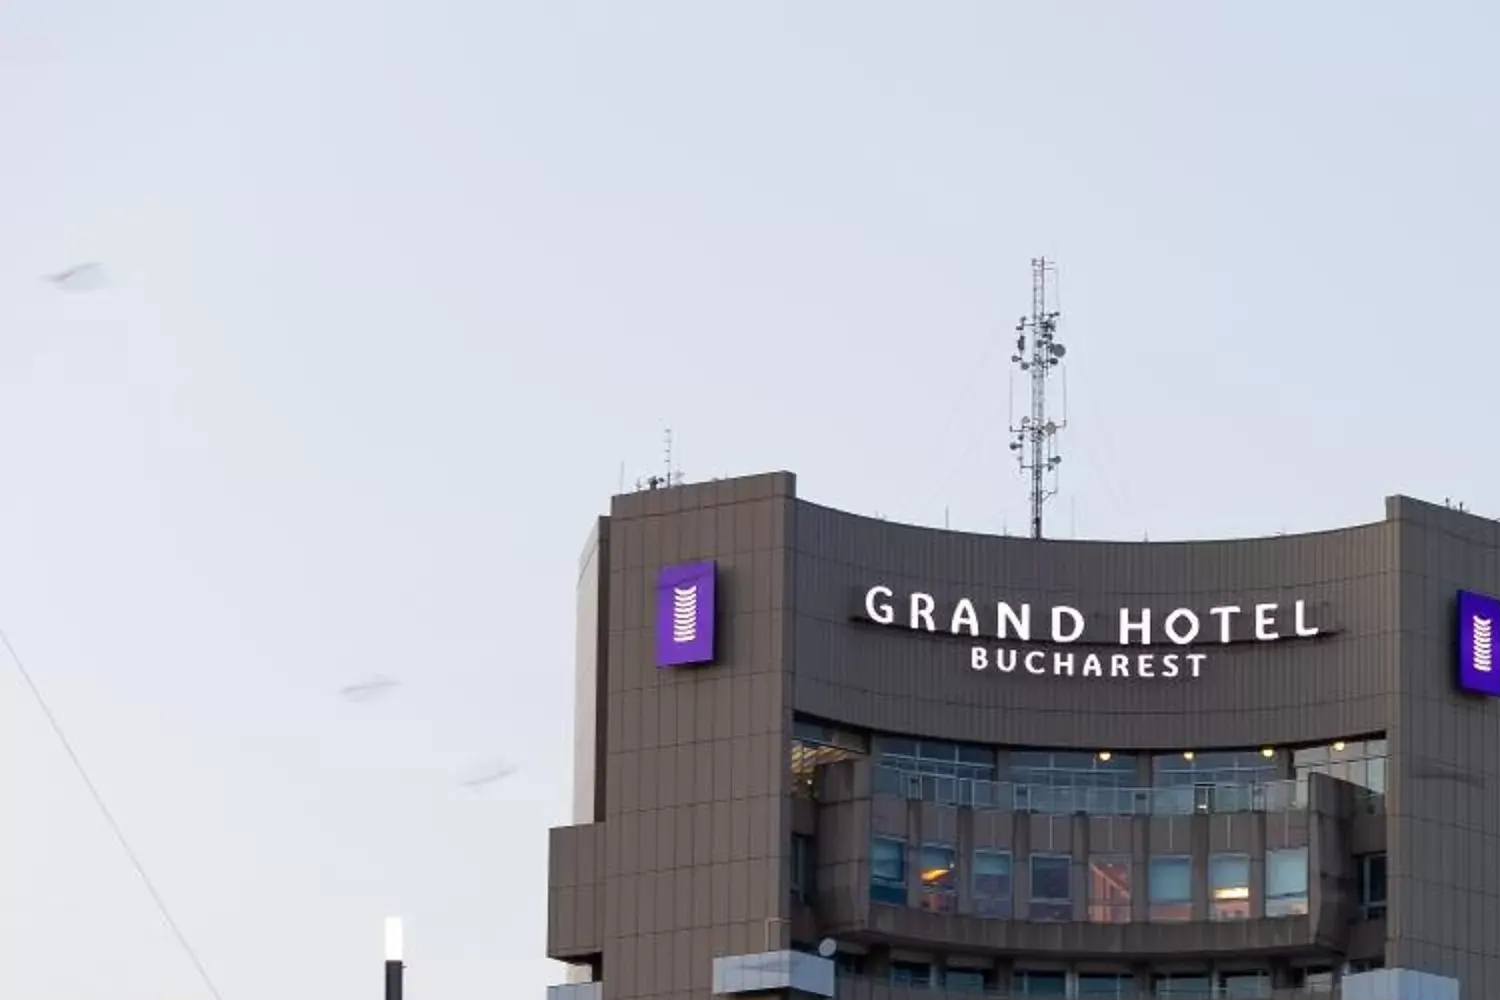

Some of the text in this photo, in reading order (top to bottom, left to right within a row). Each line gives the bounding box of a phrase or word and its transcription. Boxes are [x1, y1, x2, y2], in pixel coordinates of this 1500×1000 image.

[865, 585, 1319, 645] GRAND HOTEL
[971, 646, 1207, 678] BUCHAREST
